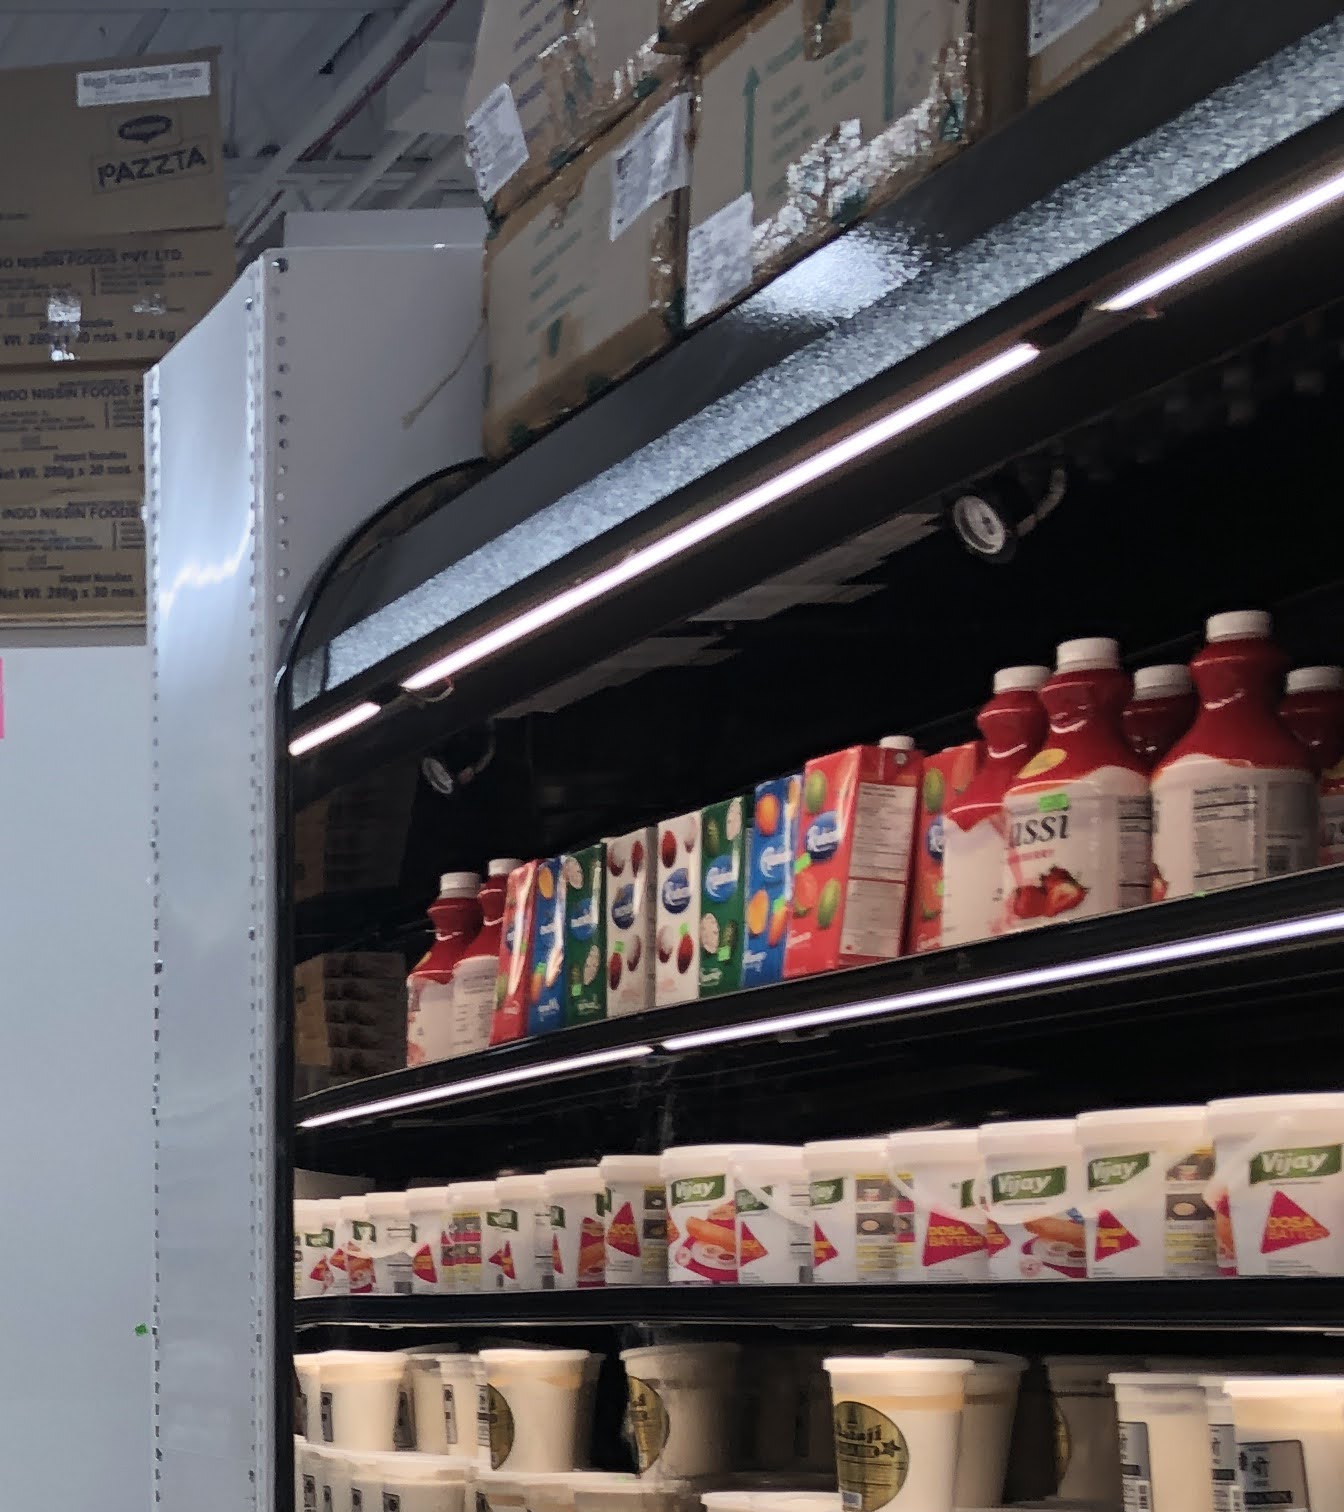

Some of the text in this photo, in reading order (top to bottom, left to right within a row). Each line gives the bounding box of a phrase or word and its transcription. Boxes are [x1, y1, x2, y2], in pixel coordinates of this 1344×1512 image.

[97, 148, 207, 188] PAZZTA
[1092, 1156, 1137, 1186] Vijay
[1260, 1148, 1326, 1177] Vijay
[672, 1179, 716, 1201] Vijay
[997, 1170, 1052, 1198] Vijay
